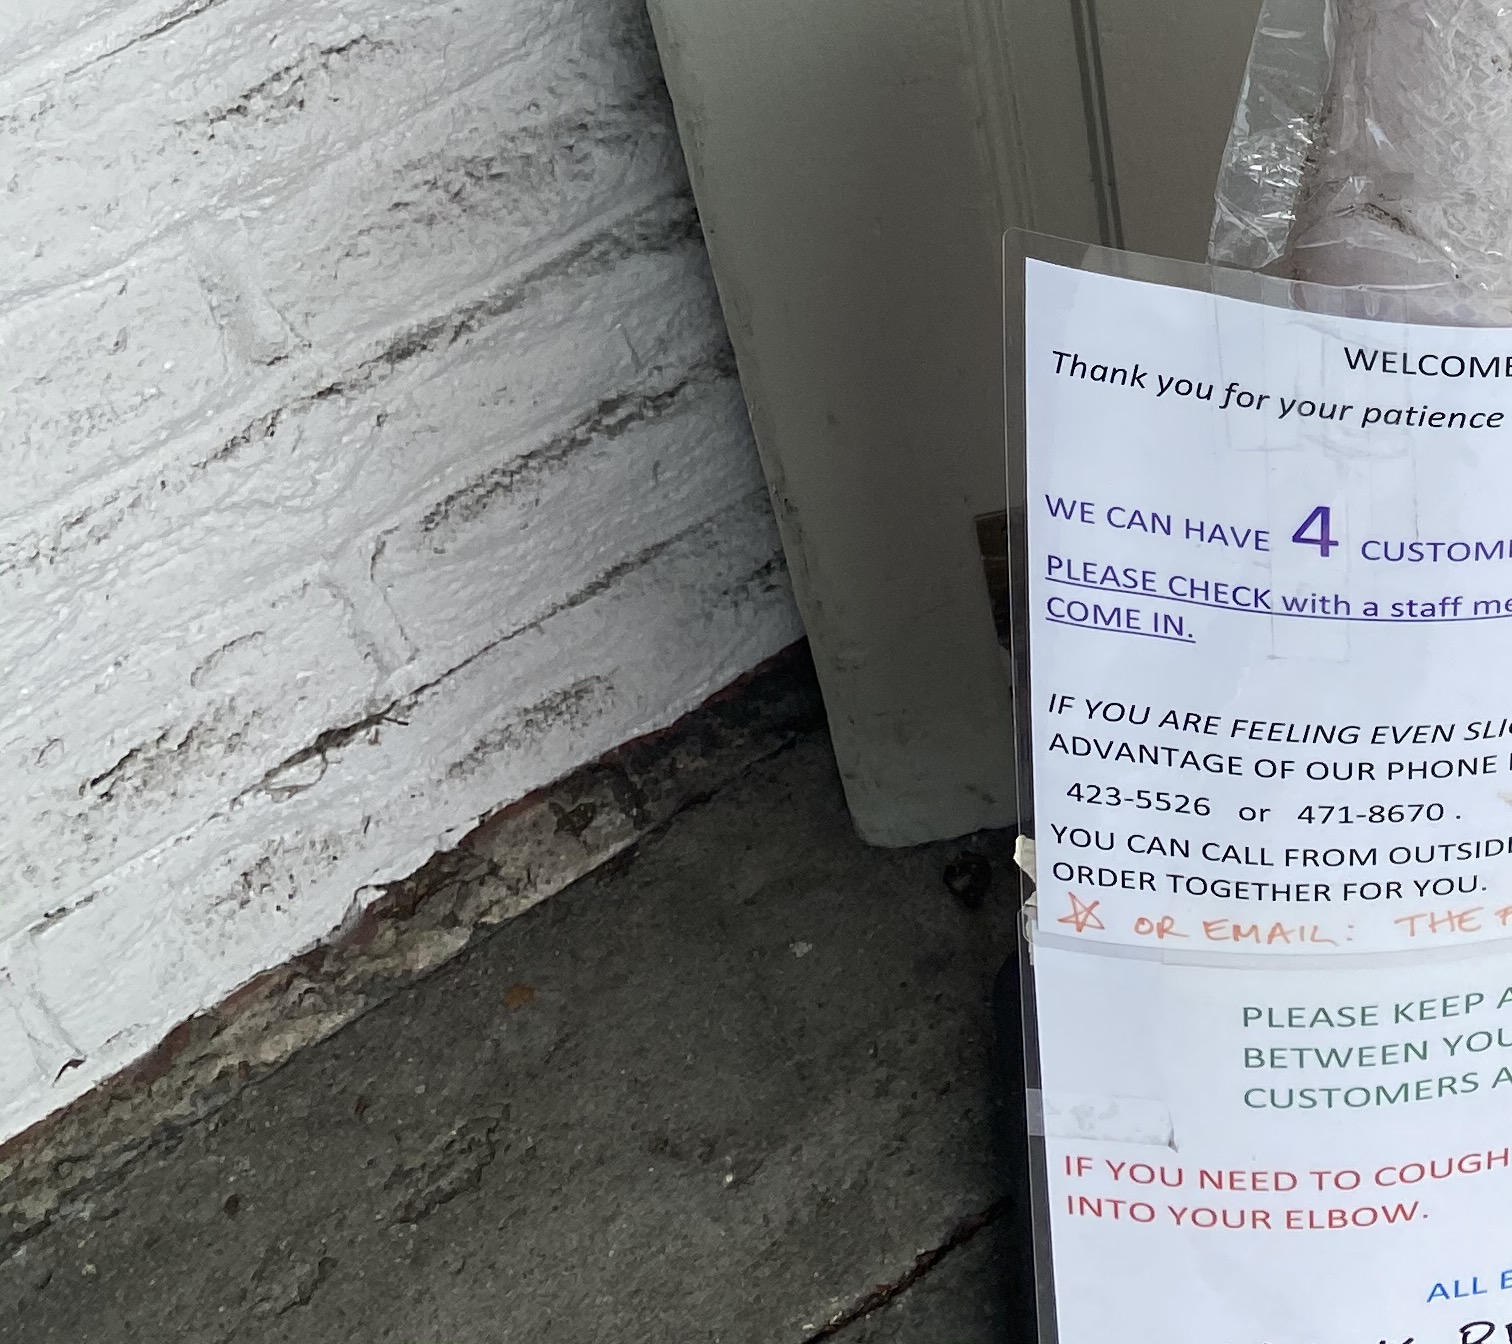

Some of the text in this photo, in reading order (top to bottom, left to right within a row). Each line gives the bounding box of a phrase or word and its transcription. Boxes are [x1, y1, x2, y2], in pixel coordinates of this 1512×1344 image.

[1053, 351, 1148, 389] Thank
[1156, 375, 1213, 400] you
[1219, 383, 1270, 410] for
[1278, 398, 1353, 421] your
[1361, 405, 1504, 428] patience
[1045, 494, 1095, 524] WE
[1107, 507, 1171, 535] CAN
[1186, 519, 1270, 551] HAVE
[1292, 506, 1339, 557] 4
[1048, 555, 1156, 592] PLEASE
[1169, 576, 1271, 609] CHECK
[1281, 593, 1350, 615] with
[1363, 602, 1378, 617] a
[1391, 596, 1463, 617] staff
[1045, 597, 1192, 638] COME IN.
[1049, 693, 1075, 714] IF
[1086, 699, 1150, 724] YOU
[1158, 710, 1221, 735] ARE
[1231, 719, 1361, 744] FEELING
[1371, 724, 1455, 744] EVEN
[1049, 733, 1243, 776] ADVANTAGE
[1255, 759, 1295, 779] OF
[1307, 762, 1375, 781] OUR
[1388, 755, 1497, 780] PHONE
[1067, 783, 1444, 824] 423-5526 or 471-8670
[1051, 824, 1114, 850] YOU
[1128, 835, 1189, 858] CAN
[1202, 843, 1274, 866] CALL
[1286, 848, 1376, 867] FROM
[1053, 862, 1486, 902] ORDER TOGETHER FOR YOU.
[1134, 916, 1189, 939] OR
[1243, 1006, 1378, 1028] PLEASE
[1395, 993, 1484, 1024] KEEP
[1245, 1041, 1427, 1068] BETWEEN
[1244, 1072, 1478, 1108] CUSTOMERS
[1066, 1156, 1092, 1177] IF
[1106, 1160, 1183, 1187] YOU
[1200, 1170, 1297, 1191] NEED
[1310, 1170, 1360, 1191] TO
[1375, 1148, 1508, 1186] COUGH
[1068, 1196, 1428, 1229] INTO YOUR ELBOW.
[1427, 1277, 1487, 1303] ALL
